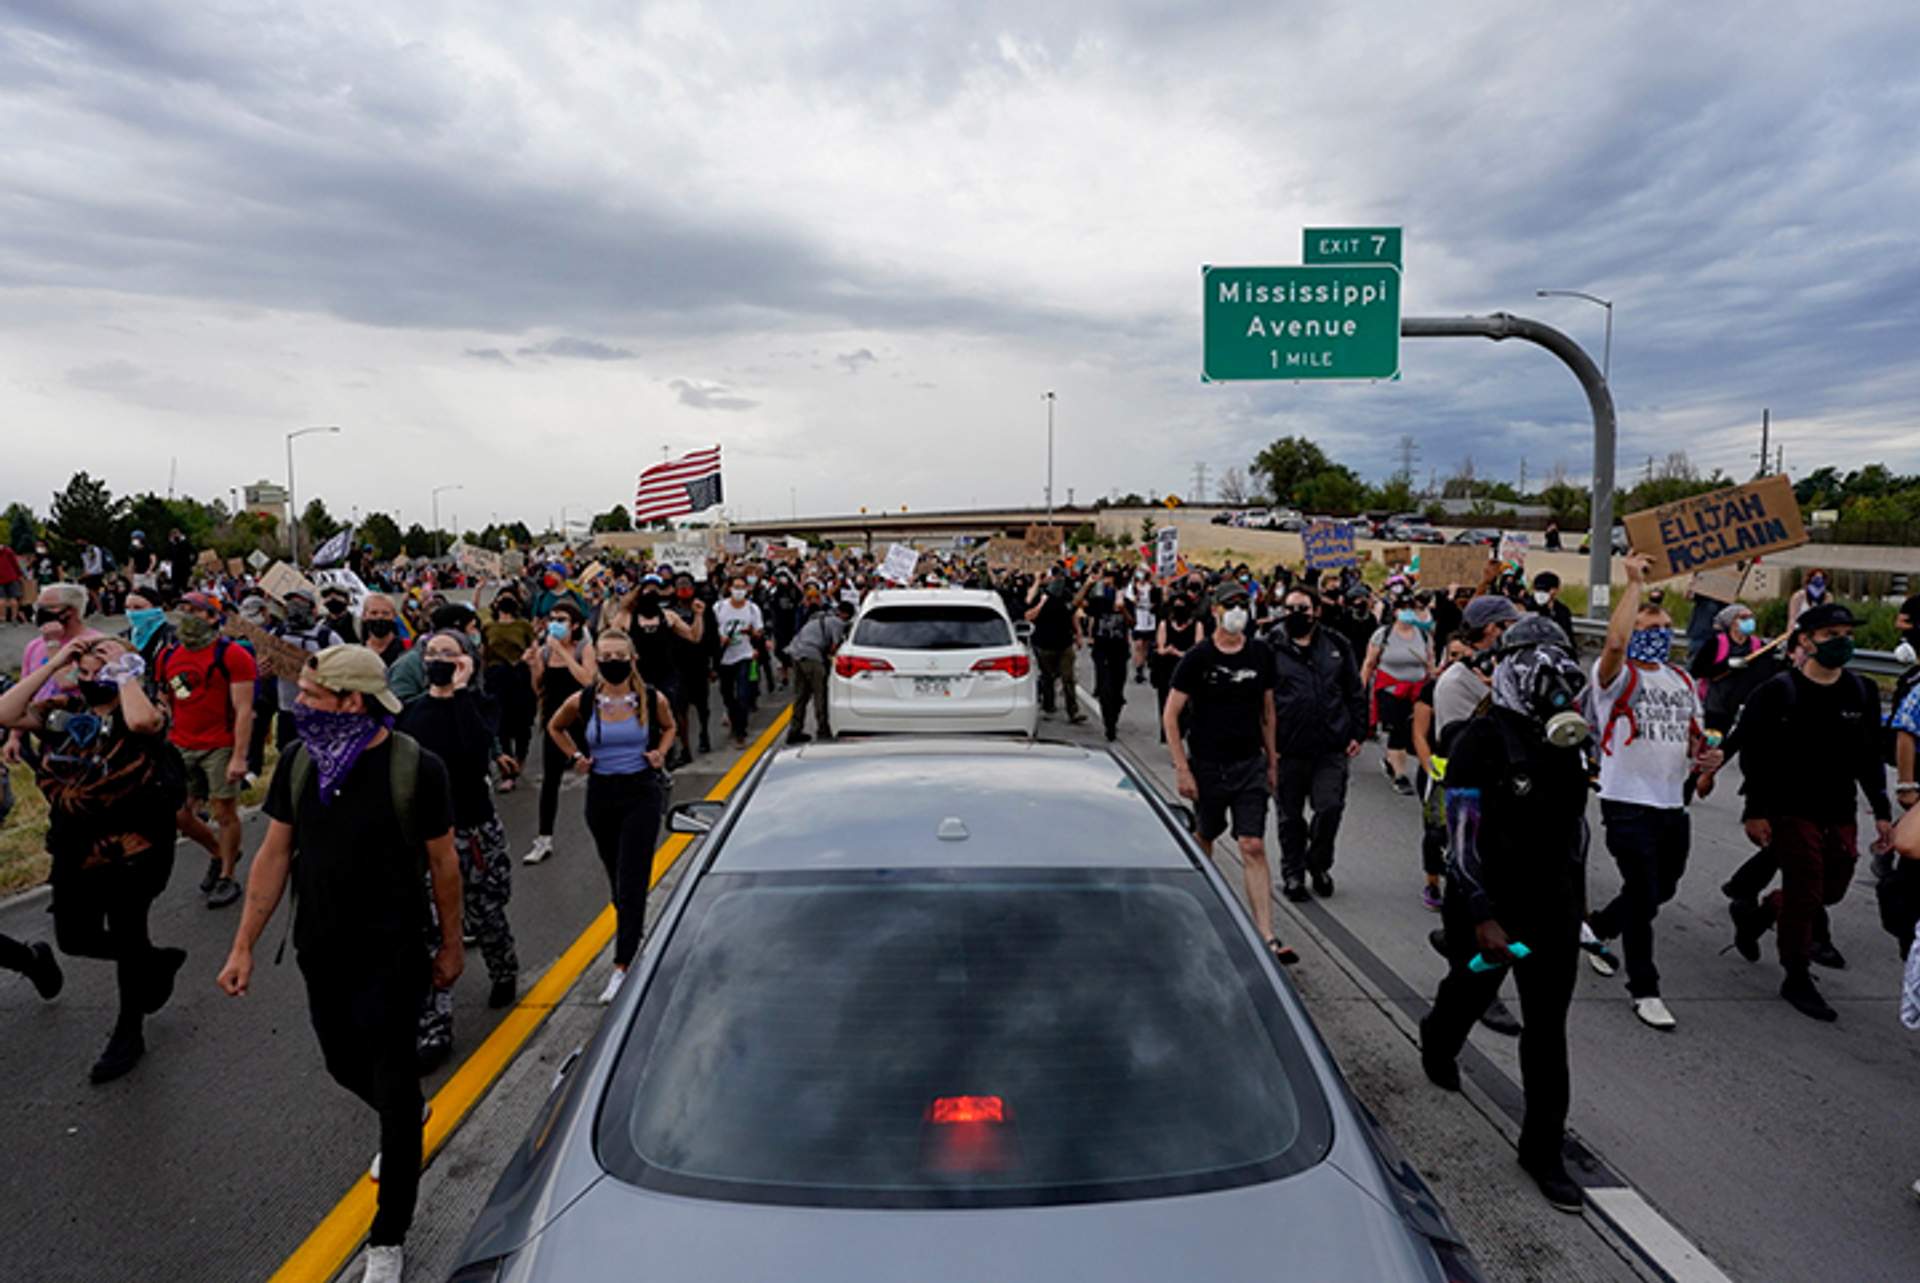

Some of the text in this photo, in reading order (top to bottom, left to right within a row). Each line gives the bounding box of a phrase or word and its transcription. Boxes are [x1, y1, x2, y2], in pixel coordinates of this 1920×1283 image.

[1319, 235, 1386, 256] EXIT 7
[1219, 280, 1387, 306] Mississippi
[1246, 315, 1357, 337] Avenue
[1270, 349, 1333, 369] 1 MILE
[1659, 493, 1766, 545] ELIJAH
[1666, 517, 1789, 575] MCCLAIN
